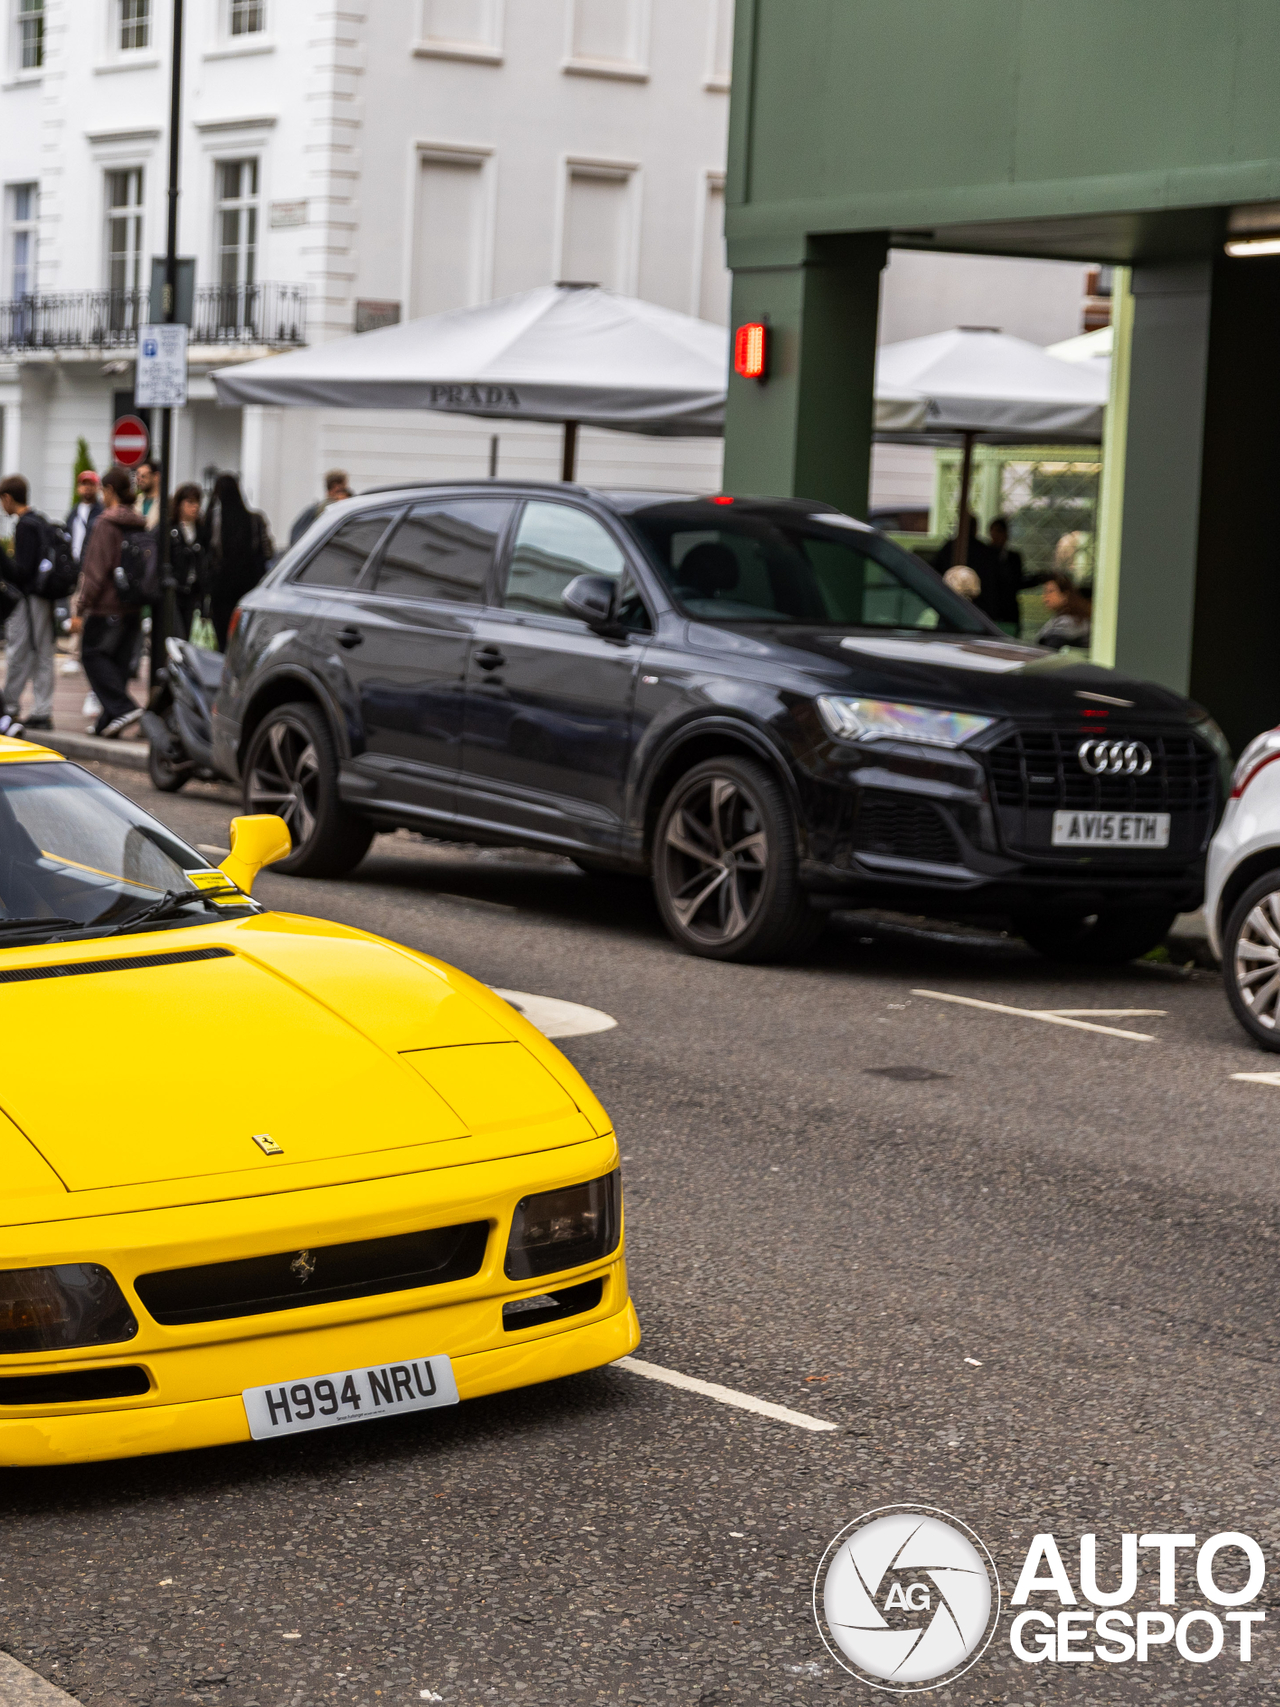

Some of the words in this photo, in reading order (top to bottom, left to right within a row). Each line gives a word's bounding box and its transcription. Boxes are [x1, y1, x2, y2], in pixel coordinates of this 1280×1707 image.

[429, 384, 521, 405] PRADA
[1068, 816, 1115, 839] AV15
[1119, 817, 1157, 840] ETH
[264, 1374, 361, 1426] H994
[367, 1361, 437, 1407] NRU
